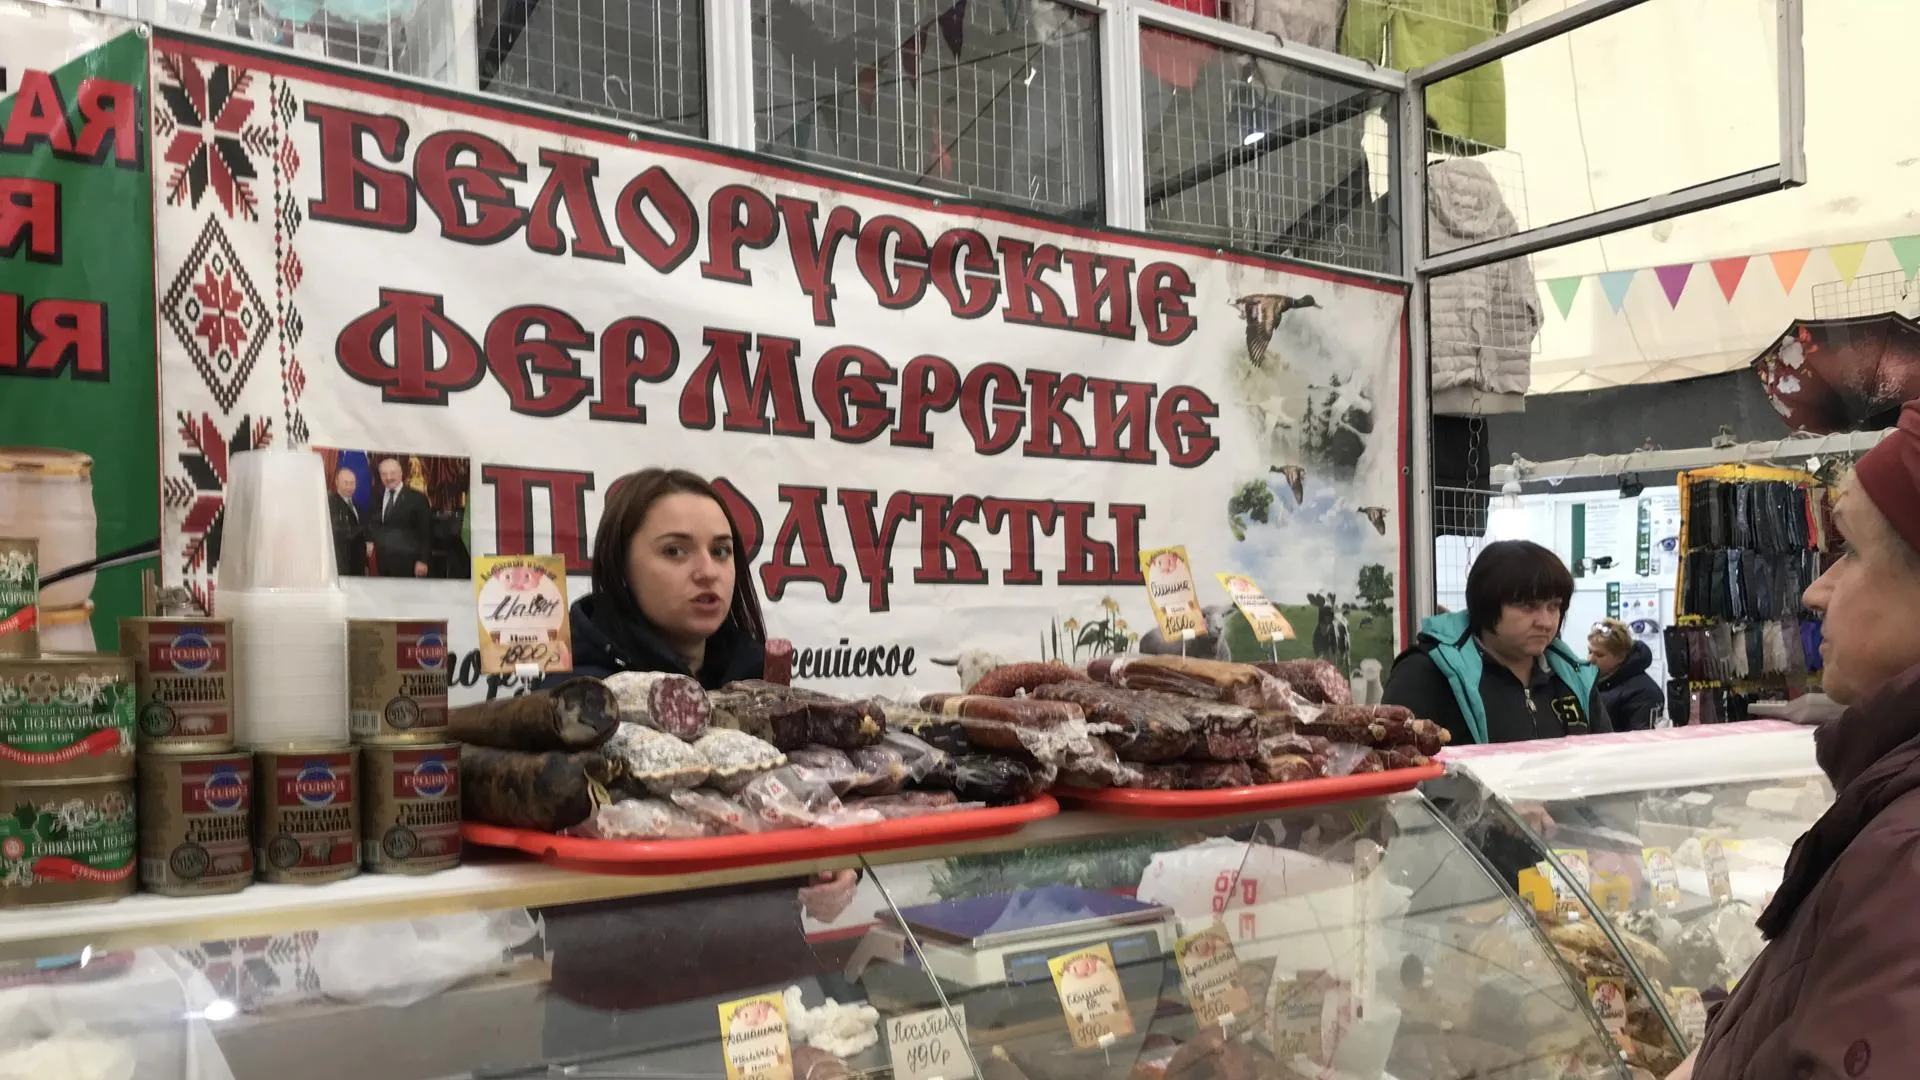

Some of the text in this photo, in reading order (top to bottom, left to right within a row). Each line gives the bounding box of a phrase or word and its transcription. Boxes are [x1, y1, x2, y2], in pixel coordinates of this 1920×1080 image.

[303, 100, 1198, 347] БЕЛОРУССКИЕ
[335, 286, 1220, 469] ФЕРМЕРСКИЕ
[481, 463, 1147, 613] ПДУКТЫ
[791, 636, 918, 679] ссийское
